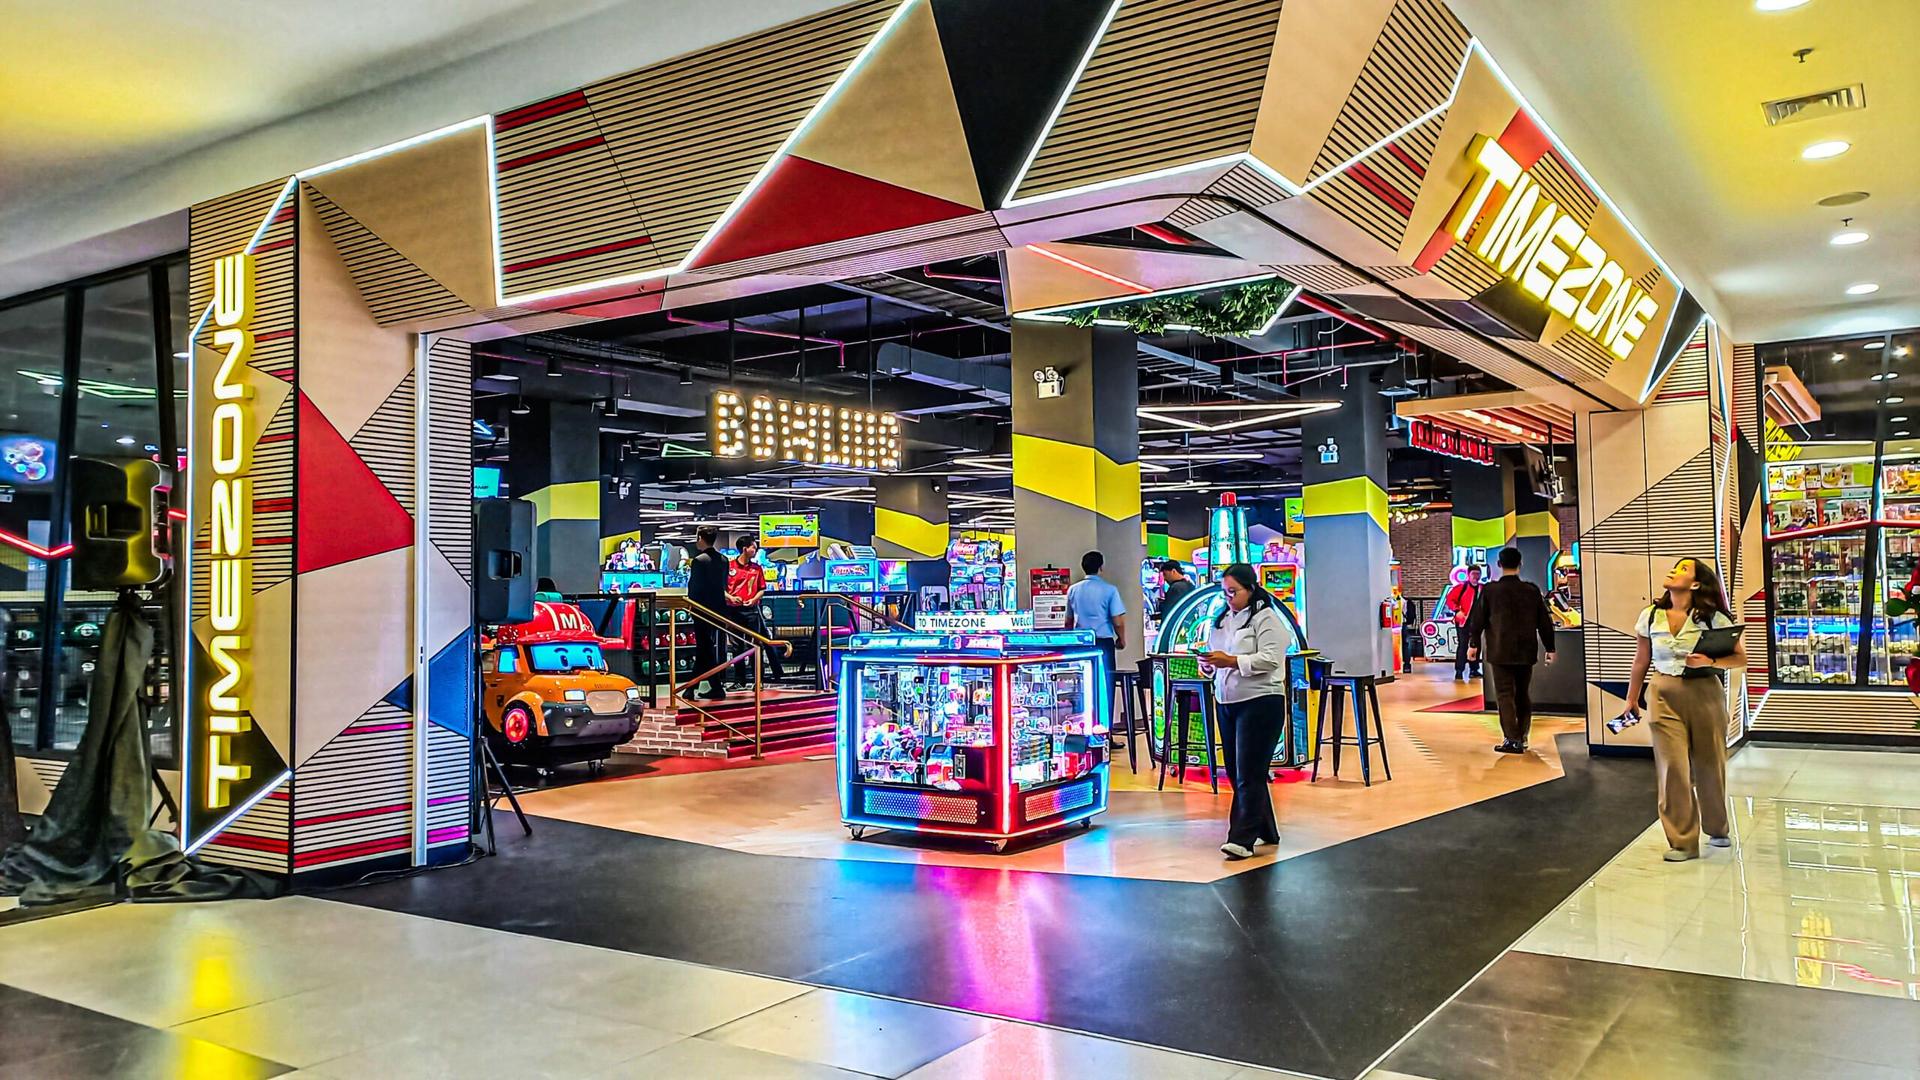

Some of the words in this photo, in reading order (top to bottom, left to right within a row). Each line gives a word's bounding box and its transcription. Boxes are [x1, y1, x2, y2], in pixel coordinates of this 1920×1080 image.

[1454, 135, 1659, 361] TIMEZONE
[713, 391, 902, 472] BOWLING
[207, 253, 252, 809] TIMEZONE
[930, 618, 986, 628] TIMEZONE
